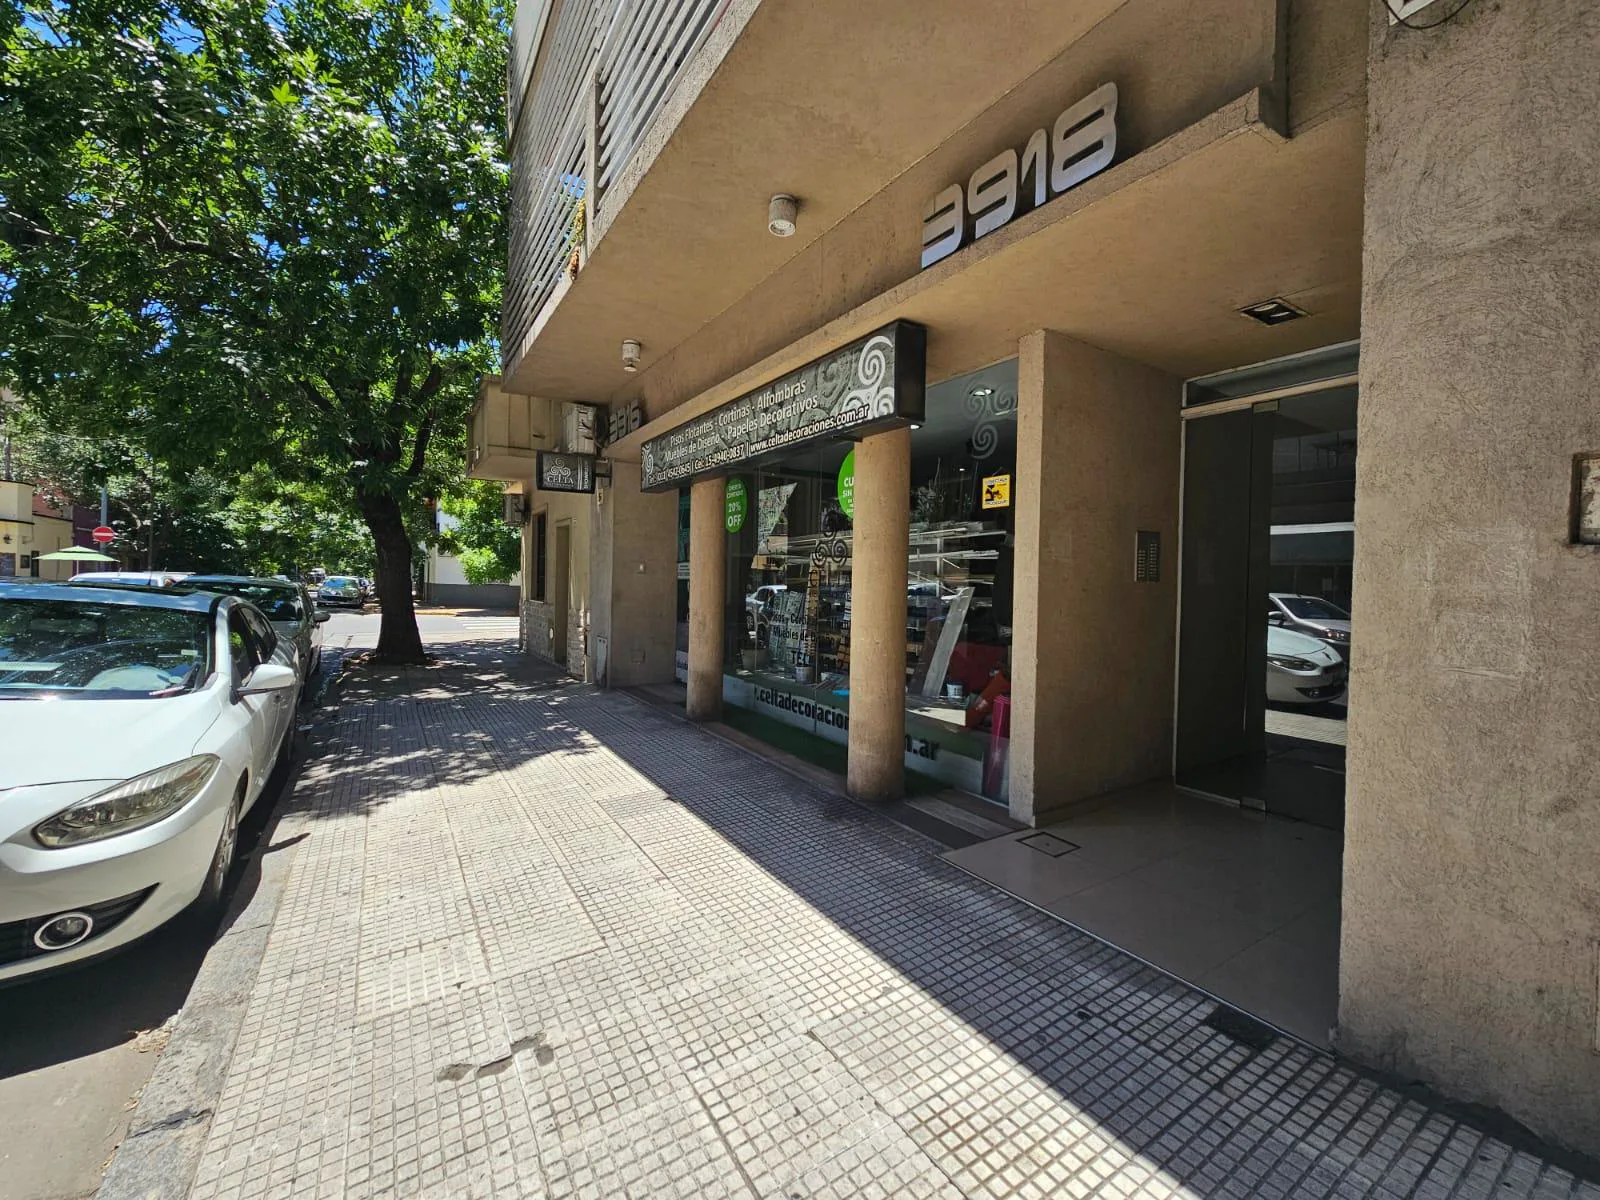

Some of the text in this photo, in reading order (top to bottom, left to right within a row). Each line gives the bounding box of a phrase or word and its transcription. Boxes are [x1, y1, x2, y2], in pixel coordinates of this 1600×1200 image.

[921, 82, 1118, 268] 3918
[665, 445, 687, 461] Muebles
[688, 441, 697, 454] de
[698, 432, 720, 450] Diseño
[728, 417, 758, 440] Papeles
[760, 394, 818, 427] Decorativos
[670, 434, 684, 447] Pisos
[718, 405, 750, 426] Cortinas
[757, 379, 806, 410] Alfombras
[750, 405, 869, 454] www.celtadecoraciones.com.ar
[727, 515, 741, 527] OFF
